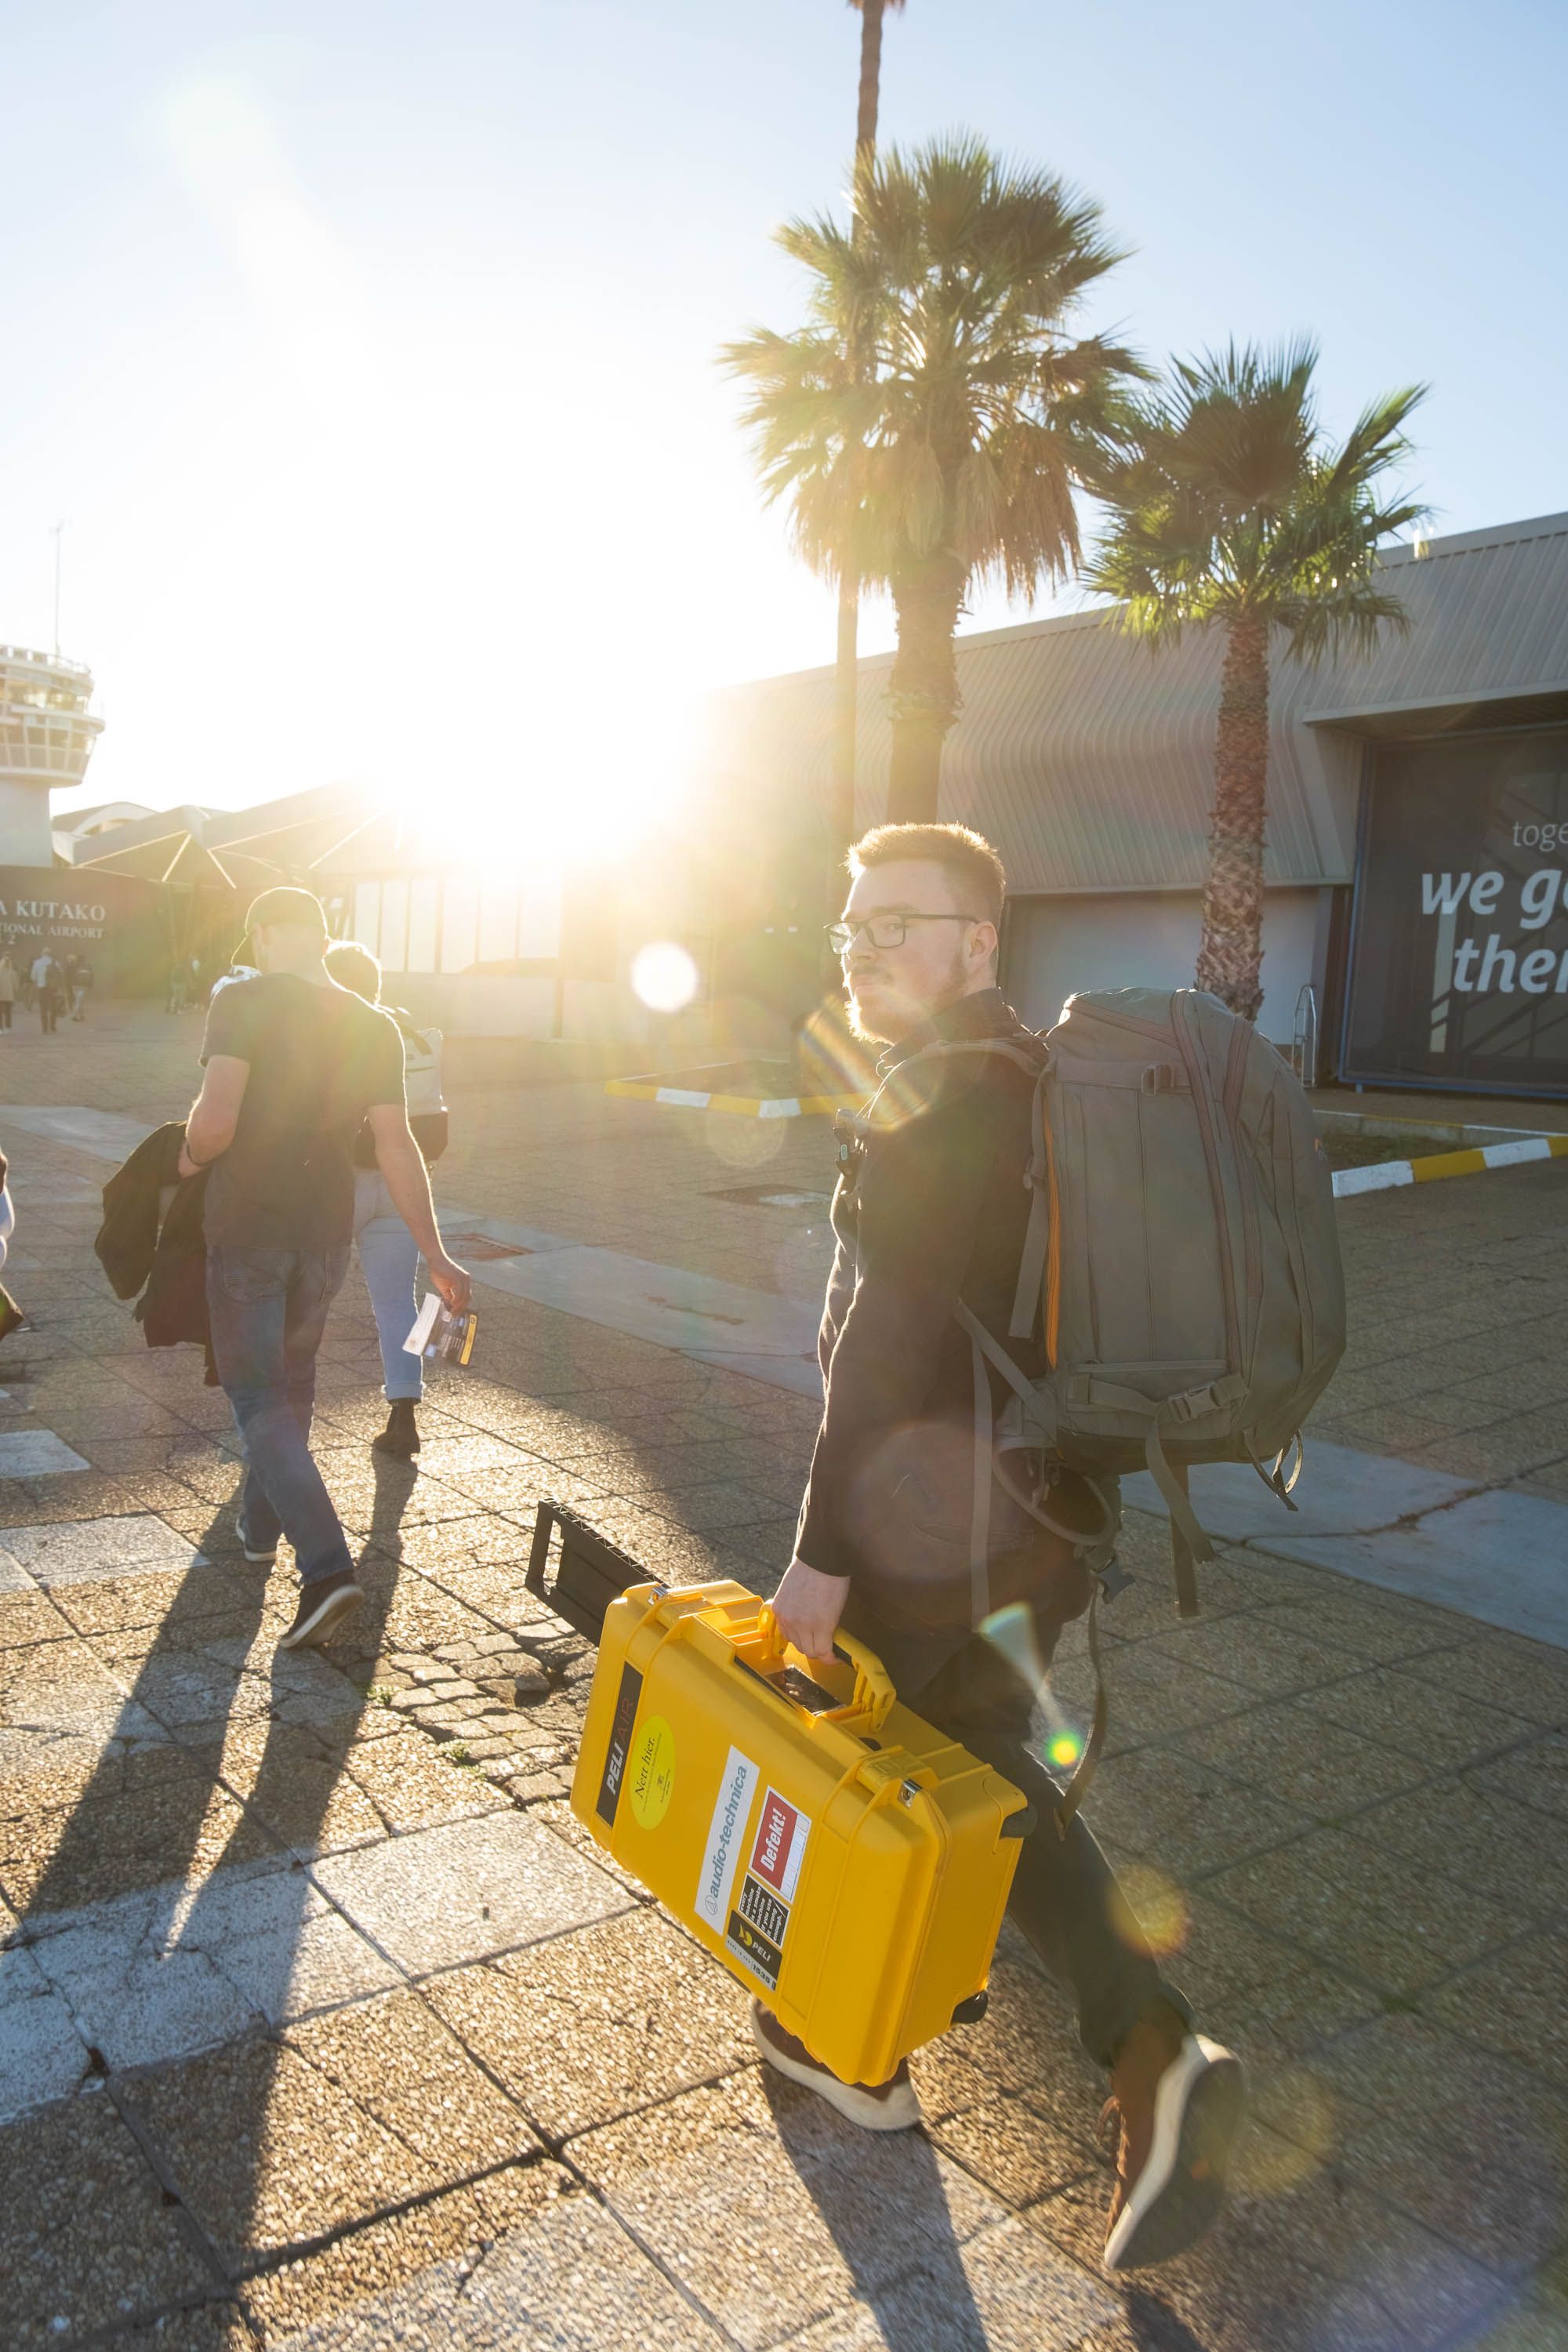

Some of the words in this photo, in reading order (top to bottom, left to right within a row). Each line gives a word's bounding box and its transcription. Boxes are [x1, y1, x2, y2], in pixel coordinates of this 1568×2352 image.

[16, 899, 106, 922] KUTAKO
[1421, 869, 1504, 916] we
[1519, 868, 1568, 931] g
[49, 924, 104, 938] AIRPORT
[641, 1737, 655, 1766] hier.
[606, 1741, 624, 1795] PELI
[634, 1766, 649, 1801] Nett
[710, 1765, 747, 1899] audio-technica
[760, 1806, 786, 1872] Defekt!
[745, 1888, 754, 1916] machine
[756, 1897, 766, 1926] machine
[752, 1940, 771, 1962] PELI
